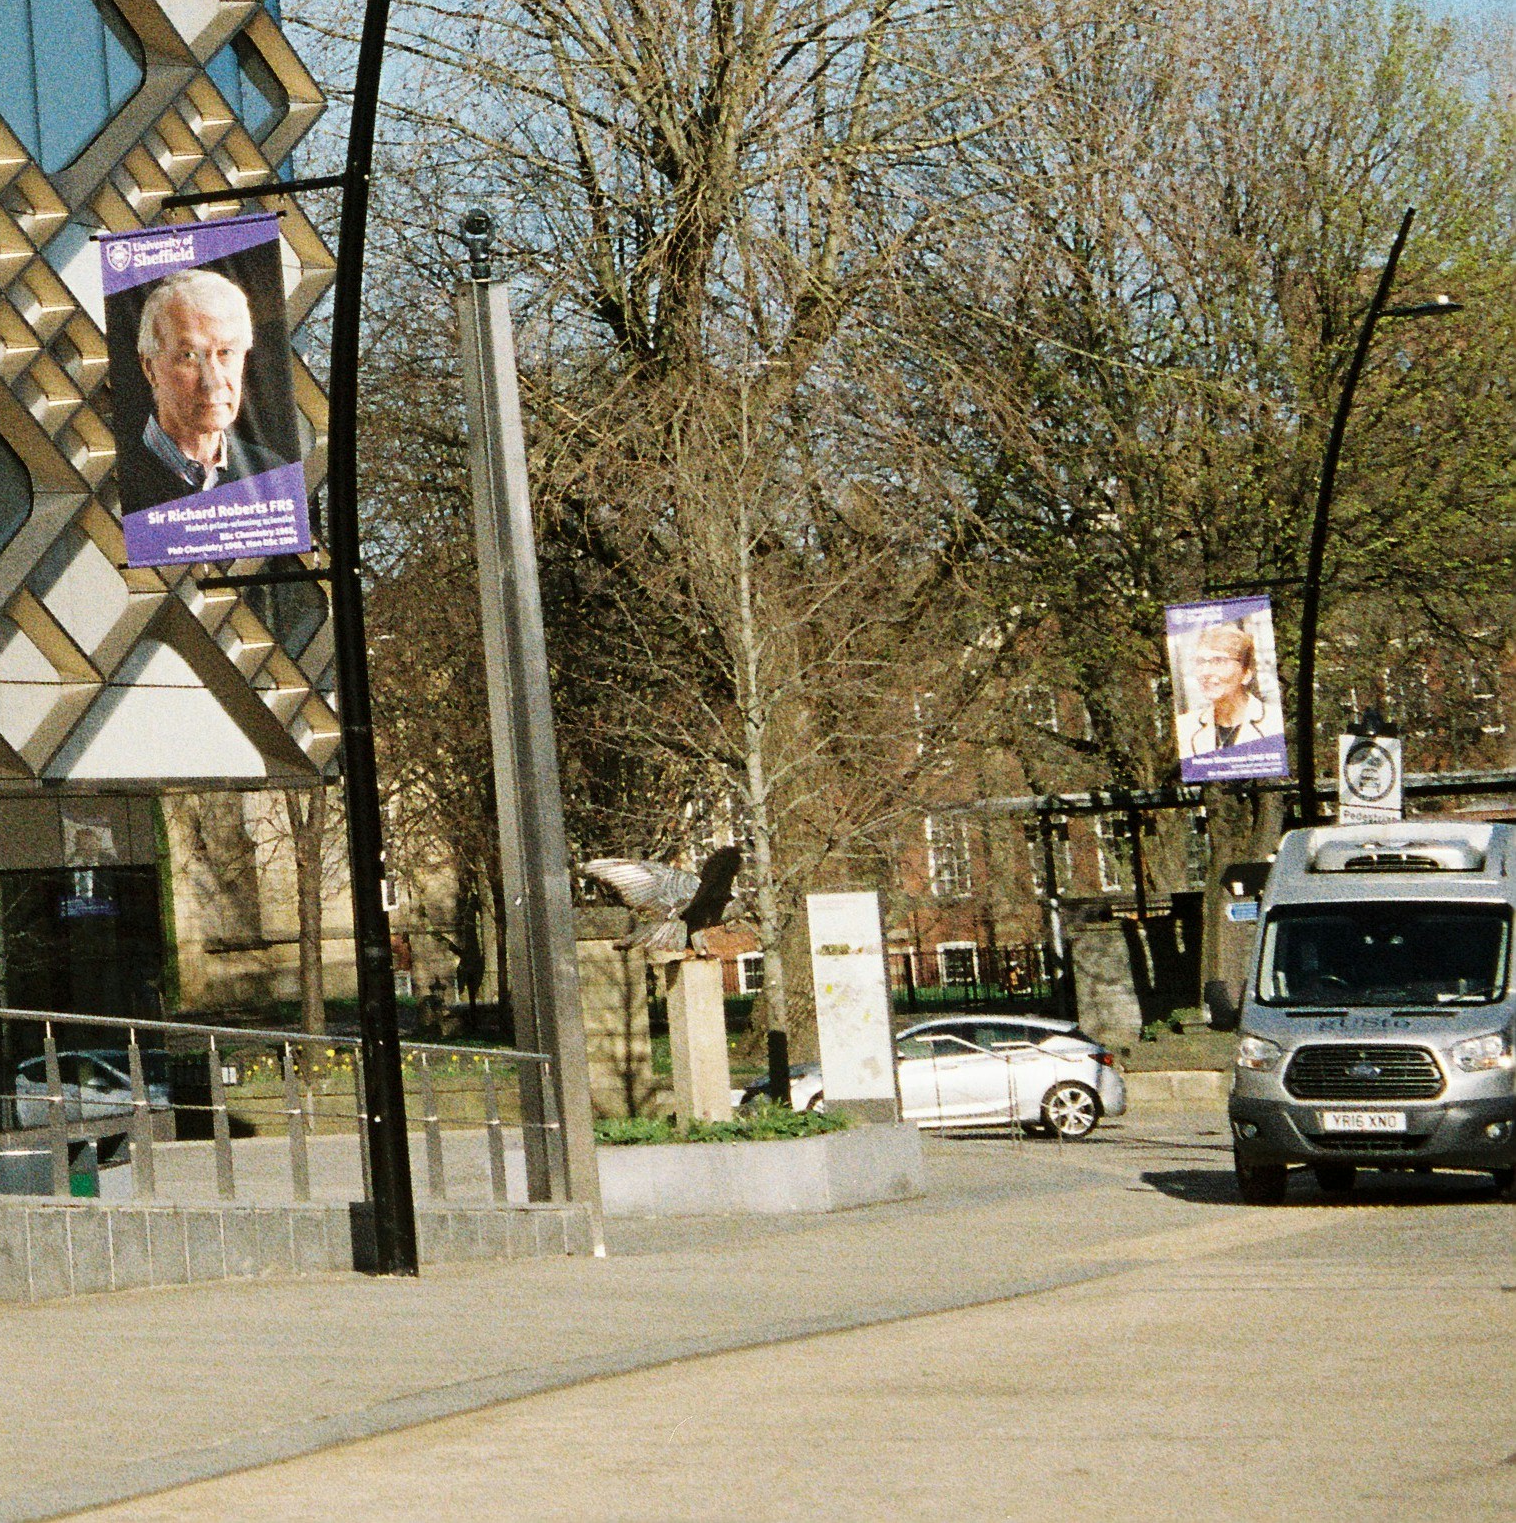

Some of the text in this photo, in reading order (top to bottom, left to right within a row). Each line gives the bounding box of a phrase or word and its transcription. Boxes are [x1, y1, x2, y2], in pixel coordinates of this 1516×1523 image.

[134, 245, 195, 267] Sheffield
[148, 498, 295, 525] Sir Richard Roberts FRS
